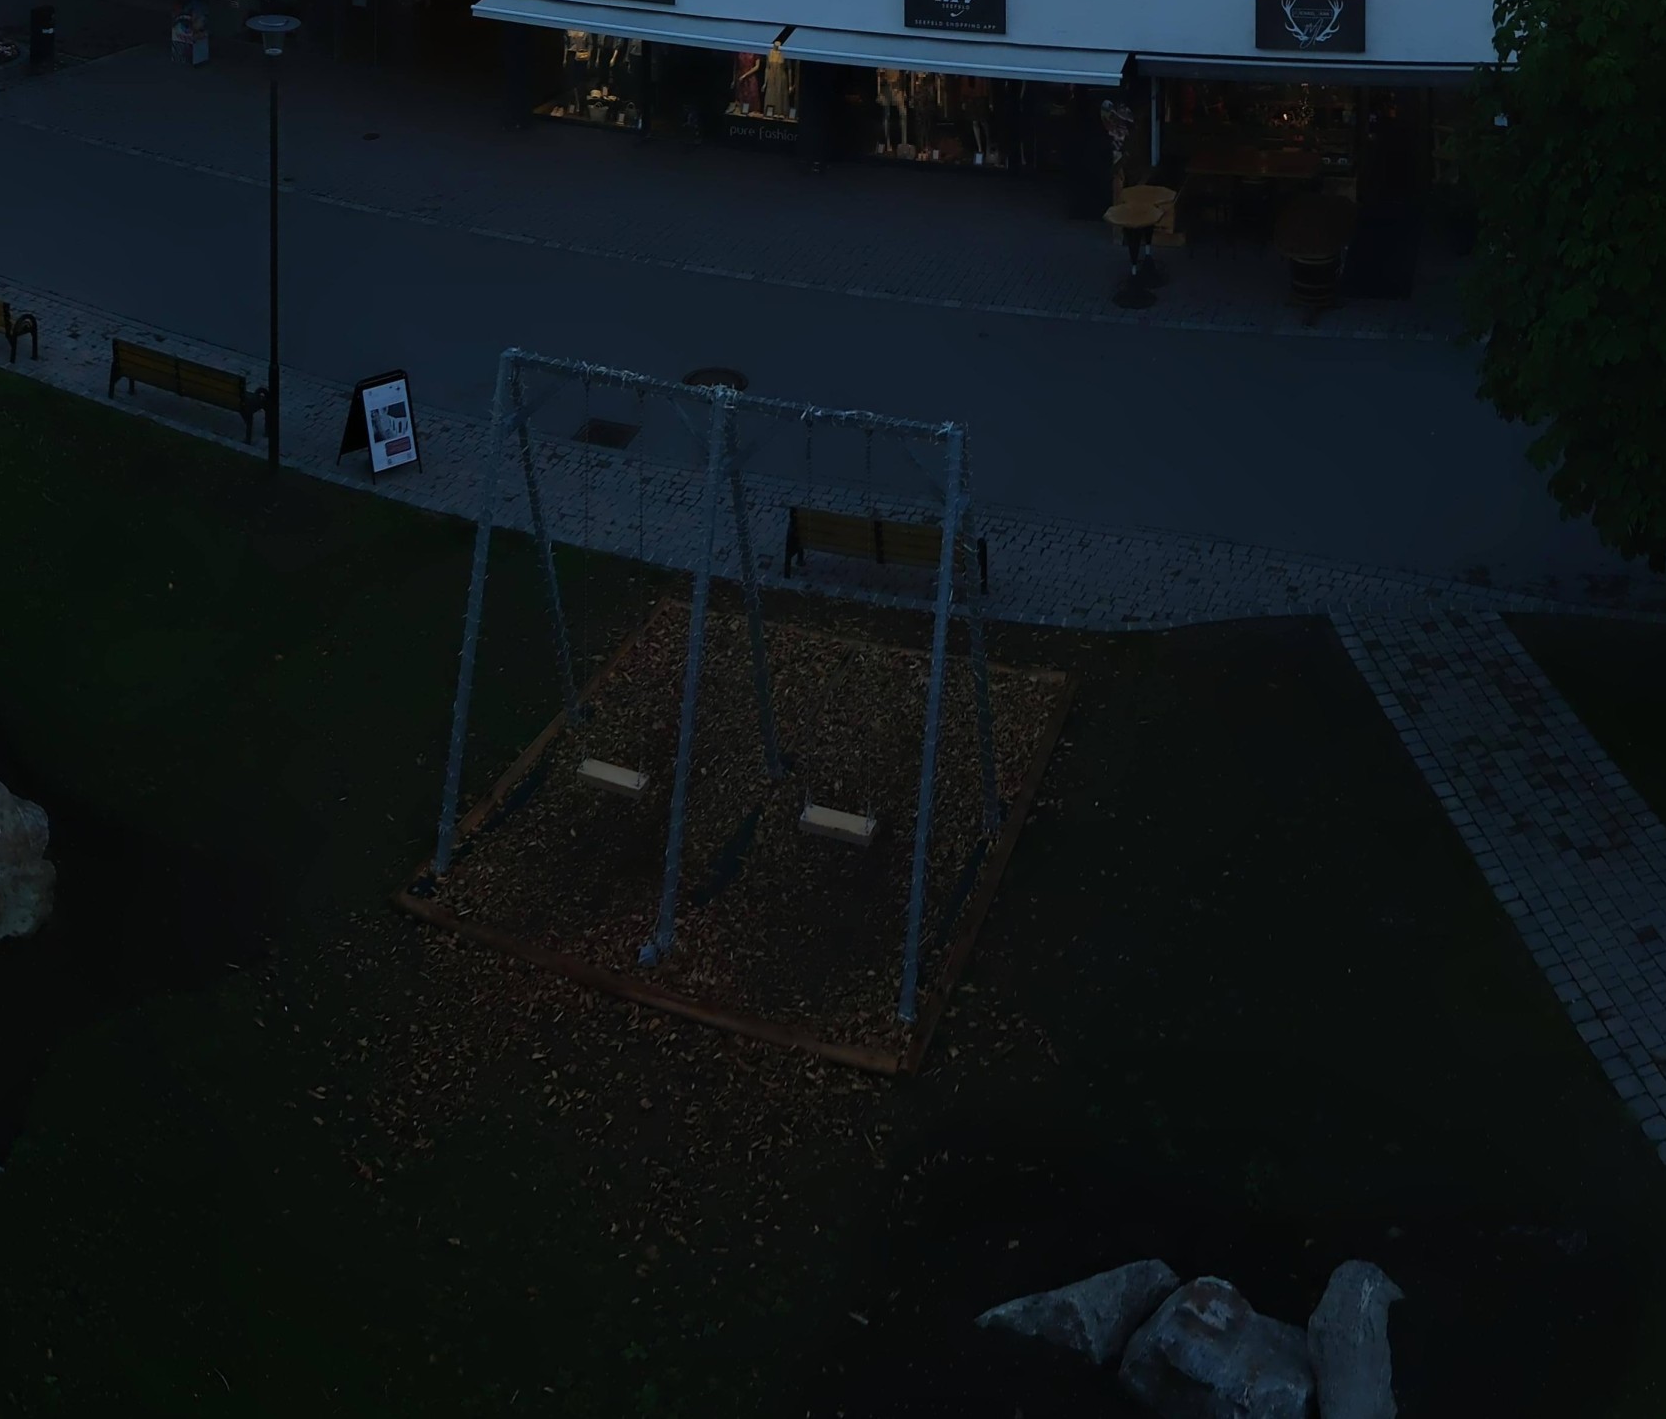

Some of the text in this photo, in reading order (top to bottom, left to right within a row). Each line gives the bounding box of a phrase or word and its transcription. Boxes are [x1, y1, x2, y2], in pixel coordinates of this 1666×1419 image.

[914, 19, 943, 27] SEEFELD
[945, 21, 981, 29] SHOPPING
[729, 125, 756, 137] pure
